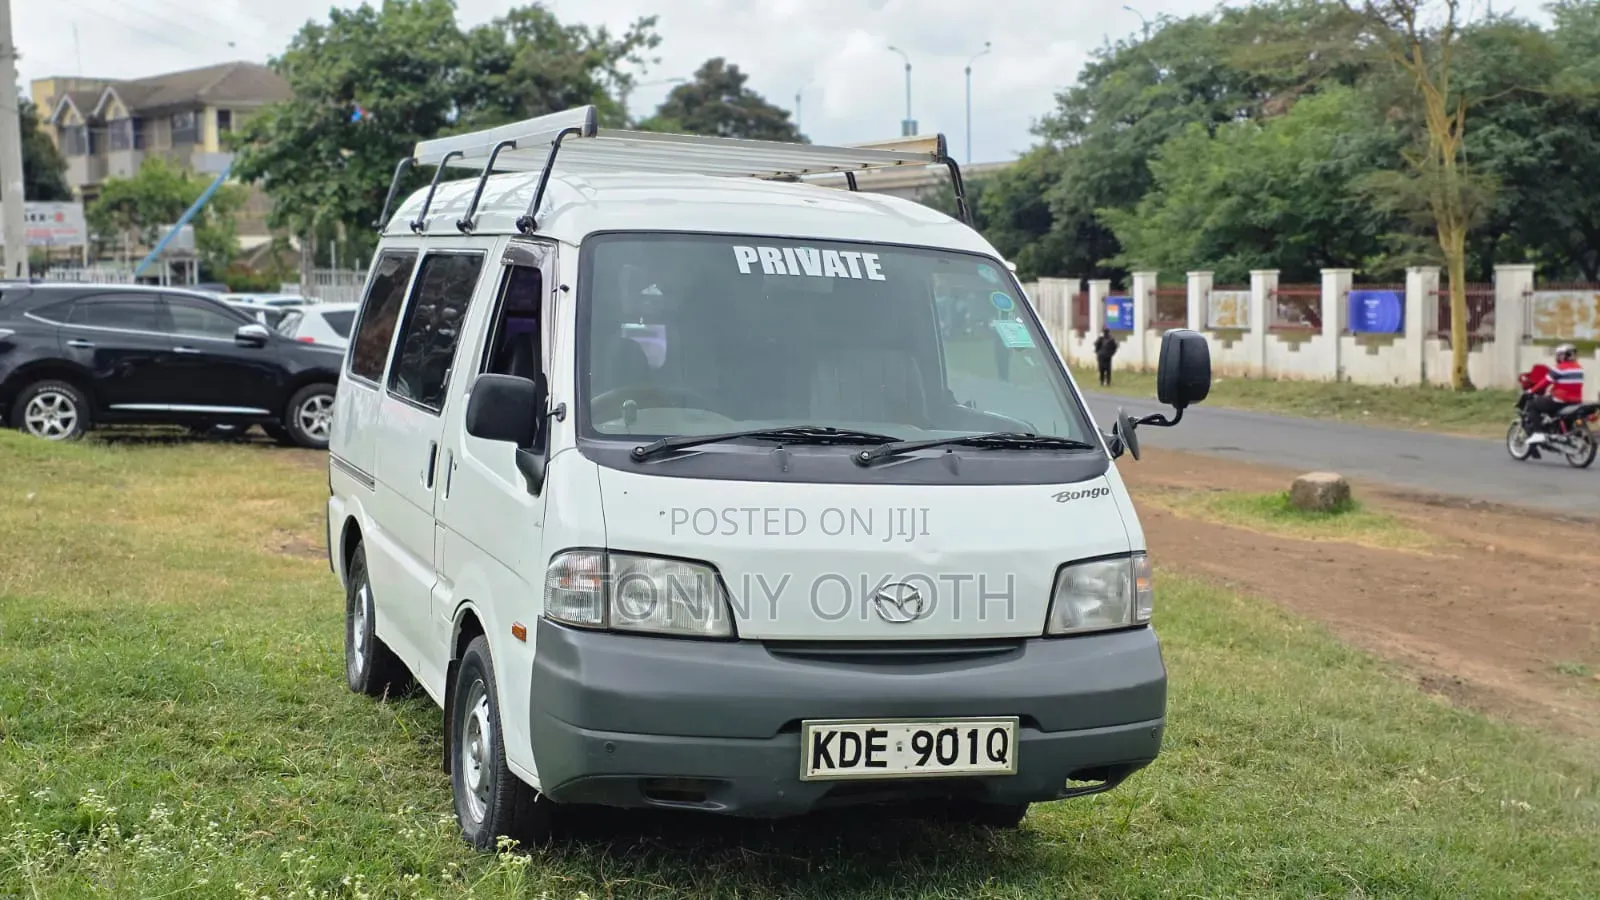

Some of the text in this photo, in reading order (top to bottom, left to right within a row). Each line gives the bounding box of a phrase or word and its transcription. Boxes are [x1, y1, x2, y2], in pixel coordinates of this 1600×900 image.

[733, 246, 886, 280] PRIVATE
[1051, 487, 1108, 503] Bongo
[812, 728, 1008, 769] KDE 901Q
